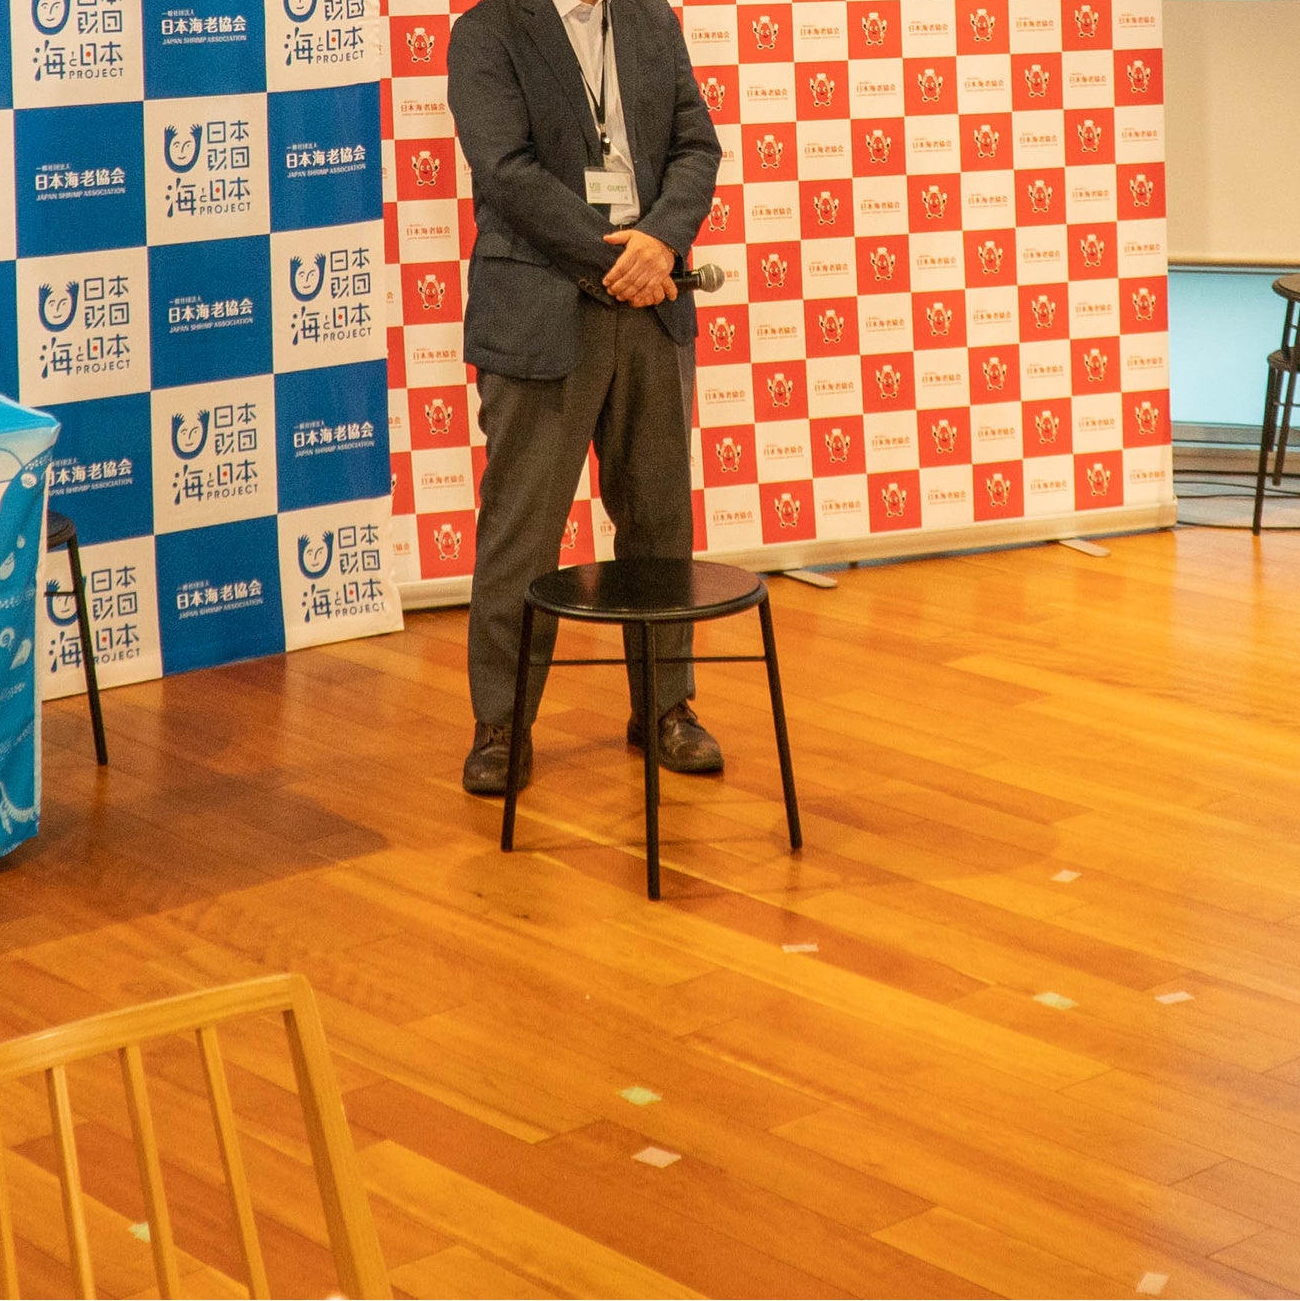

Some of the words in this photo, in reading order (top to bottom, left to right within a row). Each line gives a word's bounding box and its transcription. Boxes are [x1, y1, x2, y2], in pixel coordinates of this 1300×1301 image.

[77, 9, 123, 35] 財団
[161, 15, 247, 35] 日本海老協会
[283, 26, 364, 67] 海と日本
[316, 49, 365, 64] PROJECT
[33, 39, 124, 82] 海と日本
[68, 67, 124, 80] PROJECT
[206, 119, 249, 145] 日本
[207, 145, 250, 171] 財団
[286, 144, 366, 169] 日本海老協会
[35, 167, 126, 191] 日本海老協会
[165, 176, 251, 218] 海と日本
[199, 201, 251, 216] PROJECT
[329, 247, 370, 275] 日本
[83, 275, 129, 302] 日本
[330, 272, 371, 299] 財団
[84, 301, 130, 330] 財団
[168, 298, 253, 324] 日本海老協会
[290, 302, 371, 346] 海と日本
[322, 328, 371, 342] PROJECT
[39, 333, 130, 379] 海と日本
[75, 359, 131, 375] PROJECT
[213, 402, 257, 429] 日本
[214, 427, 258, 456] 財団
[293, 421, 374, 448] 日本海老協会
[172, 459, 258, 506] 海と日本
[206, 485, 258, 500] PROJECT
[337, 523, 379, 550] 日本
[339, 548, 381, 575] 財団
[91, 565, 137, 594] 日本
[92, 591, 139, 621] 財団
[176, 579, 262, 610] 日本海老協会
[301, 578, 383, 623] 海と日本
[334, 602, 385, 618] PROJECT
[48, 623, 140, 673] 海日本
